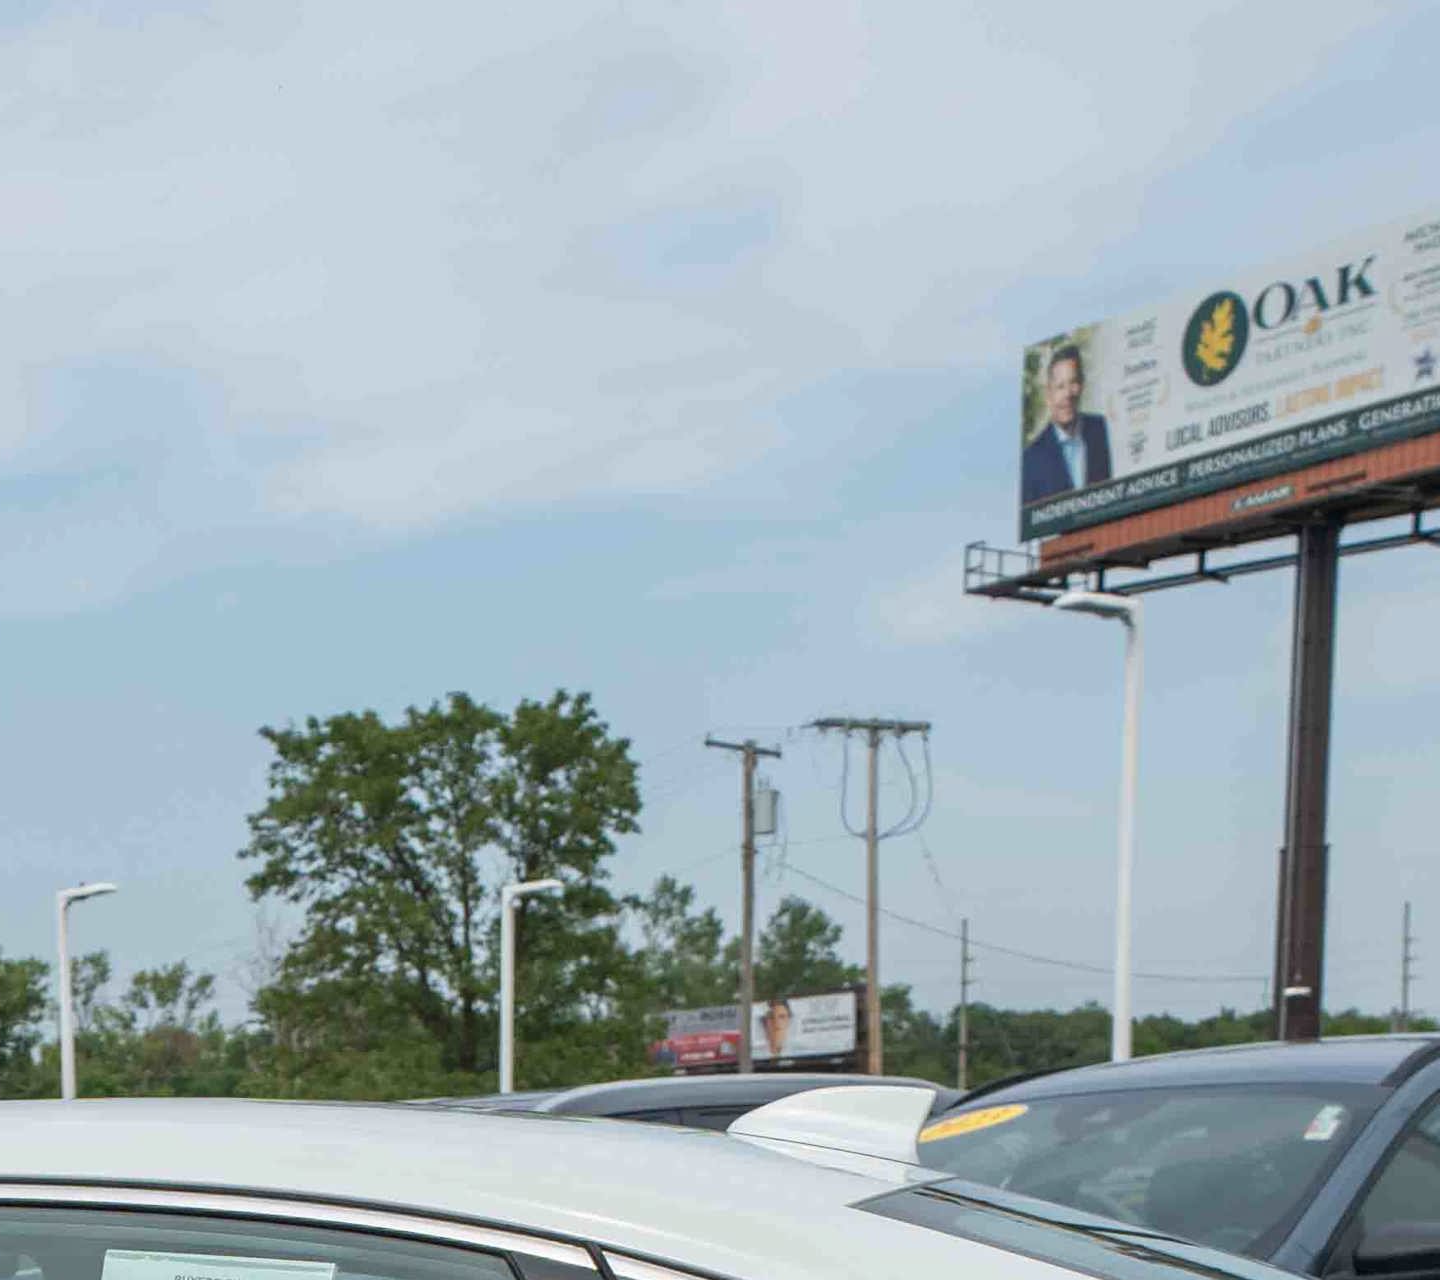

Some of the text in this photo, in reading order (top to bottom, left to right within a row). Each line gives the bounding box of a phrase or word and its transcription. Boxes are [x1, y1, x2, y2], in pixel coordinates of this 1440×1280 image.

[1252, 254, 1380, 331] OAK
[1030, 483, 1123, 525] INDEPENDENT
[1124, 470, 1179, 501] ADVICE
[1188, 427, 1297, 480] PERSONALIZED
[1298, 418, 1349, 447] PLANS
